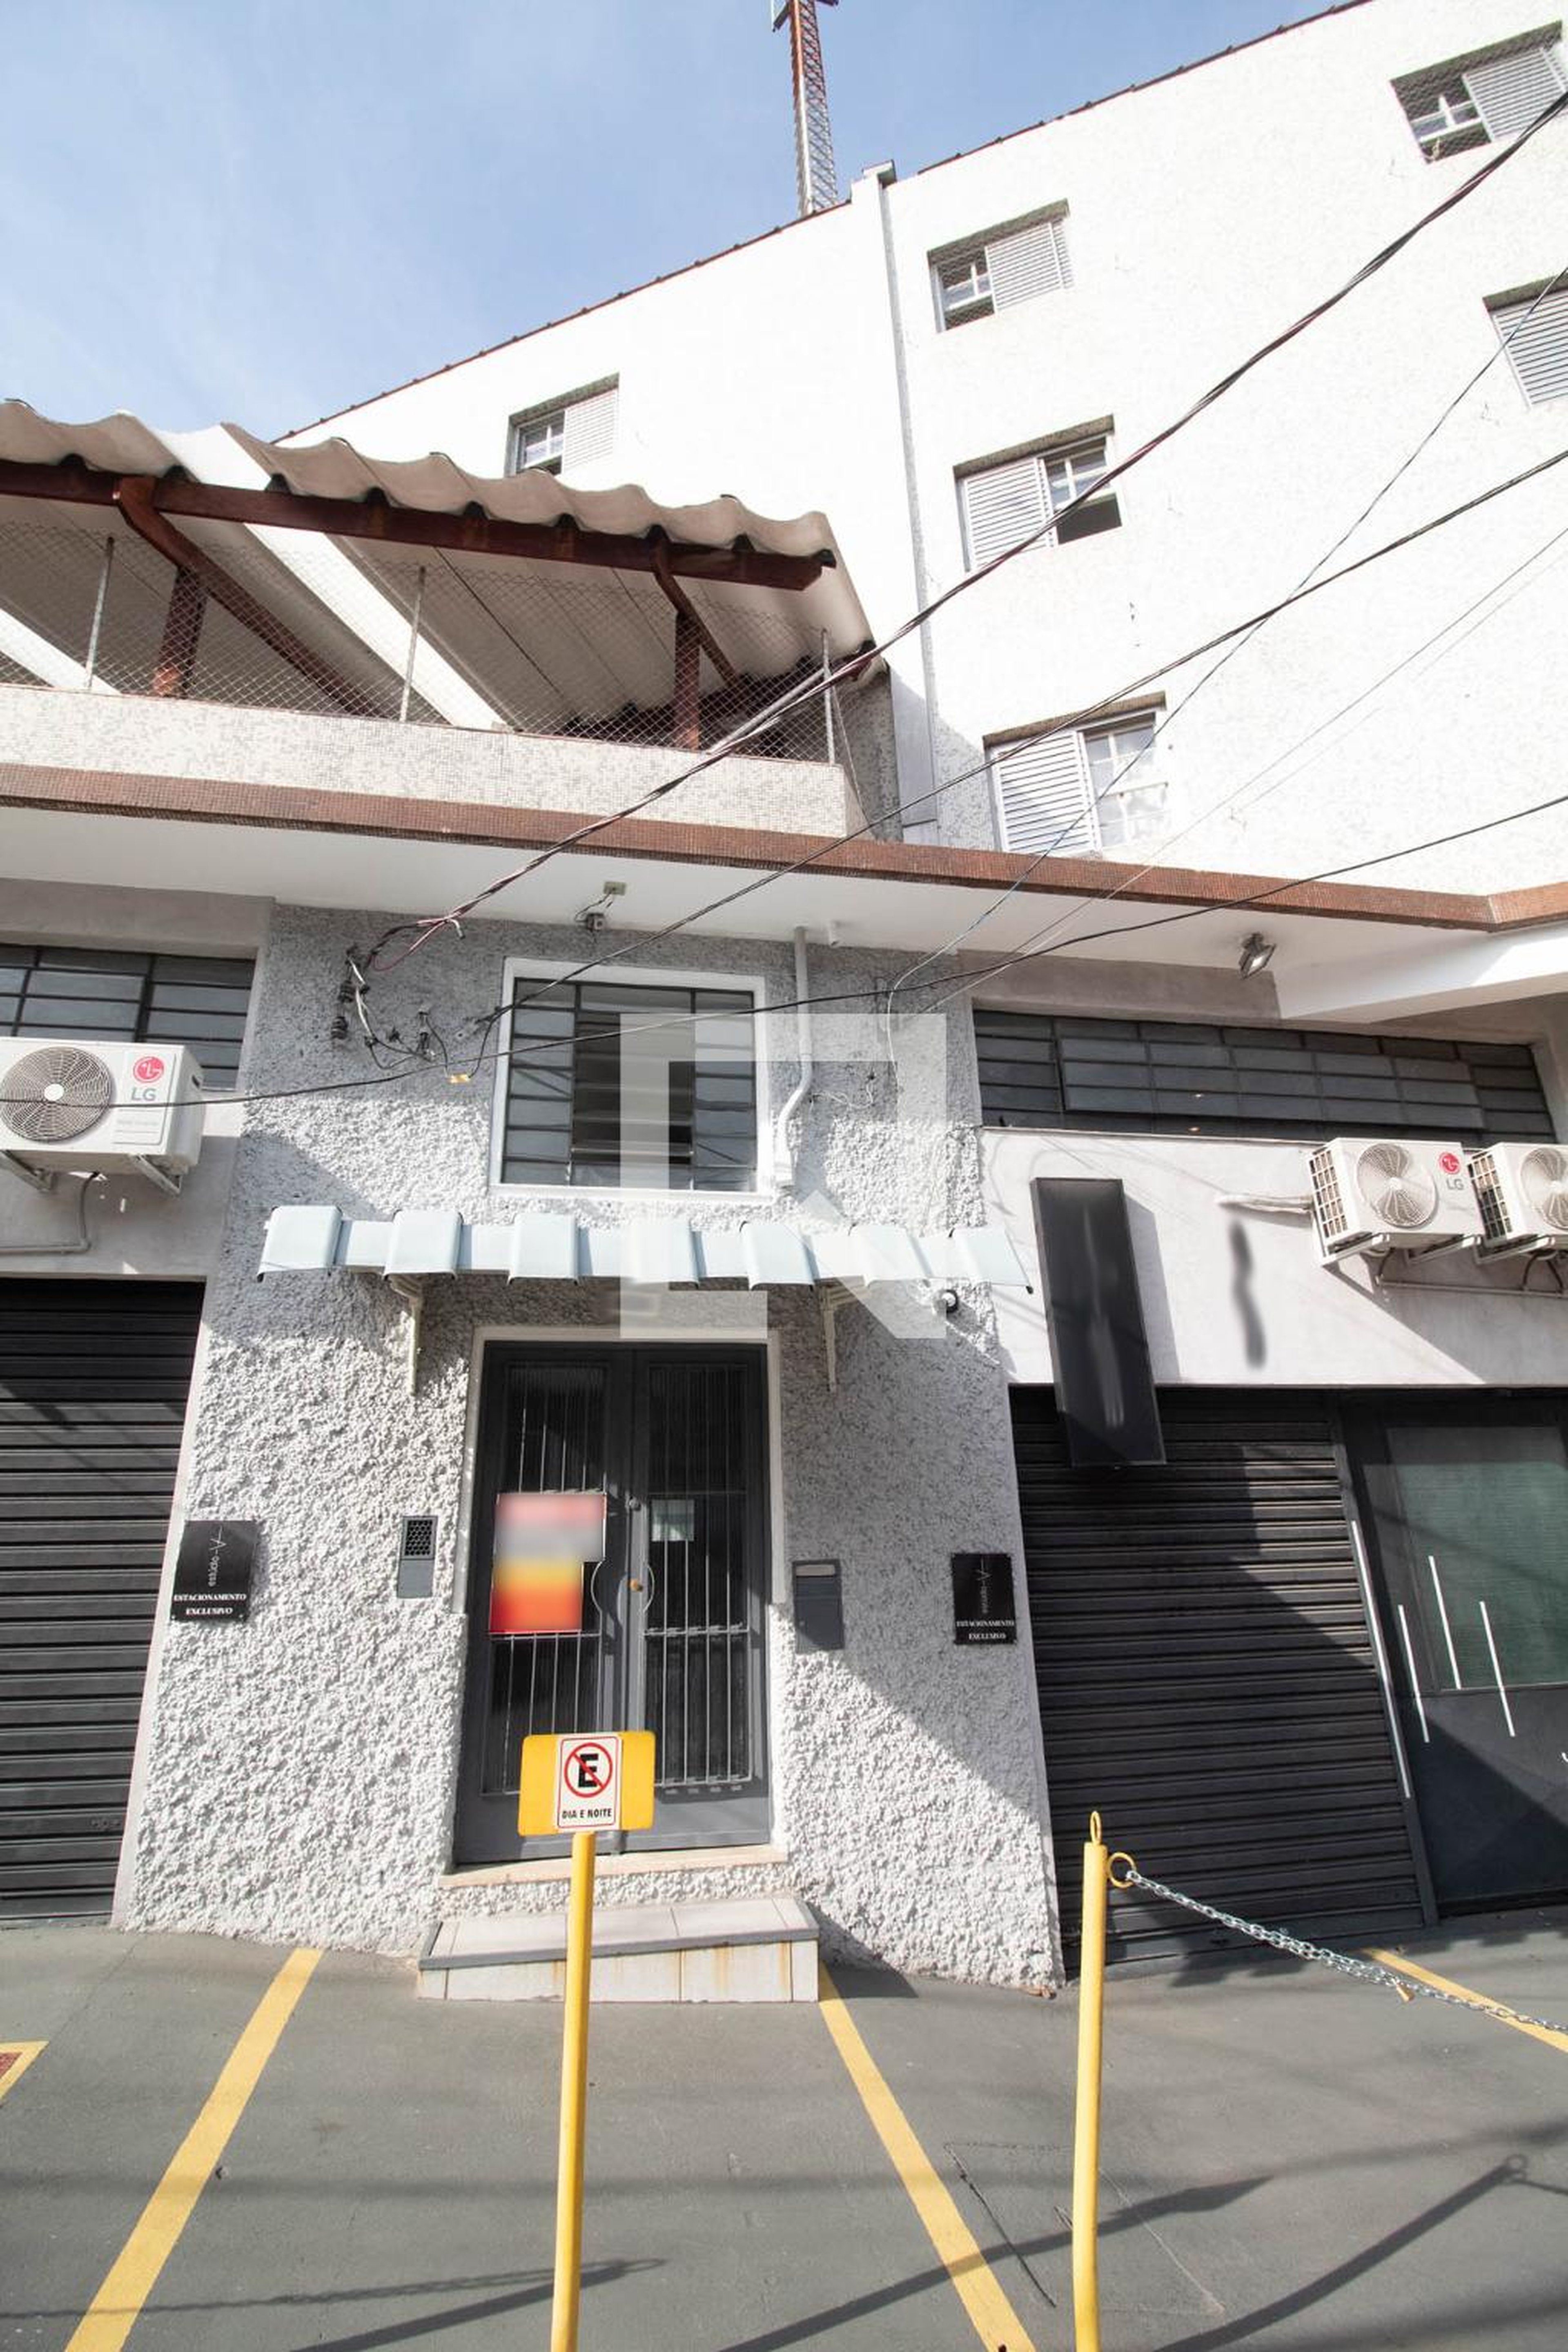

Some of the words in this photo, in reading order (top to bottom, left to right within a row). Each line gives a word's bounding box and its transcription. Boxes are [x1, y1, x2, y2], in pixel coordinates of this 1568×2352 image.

[131, 1087, 156, 1101] LG
[1446, 1178, 1463, 1190] LG
[562, 1810, 577, 1818] DIA
[580, 1809, 585, 1818] E
[588, 1809, 612, 1817] NOITE
